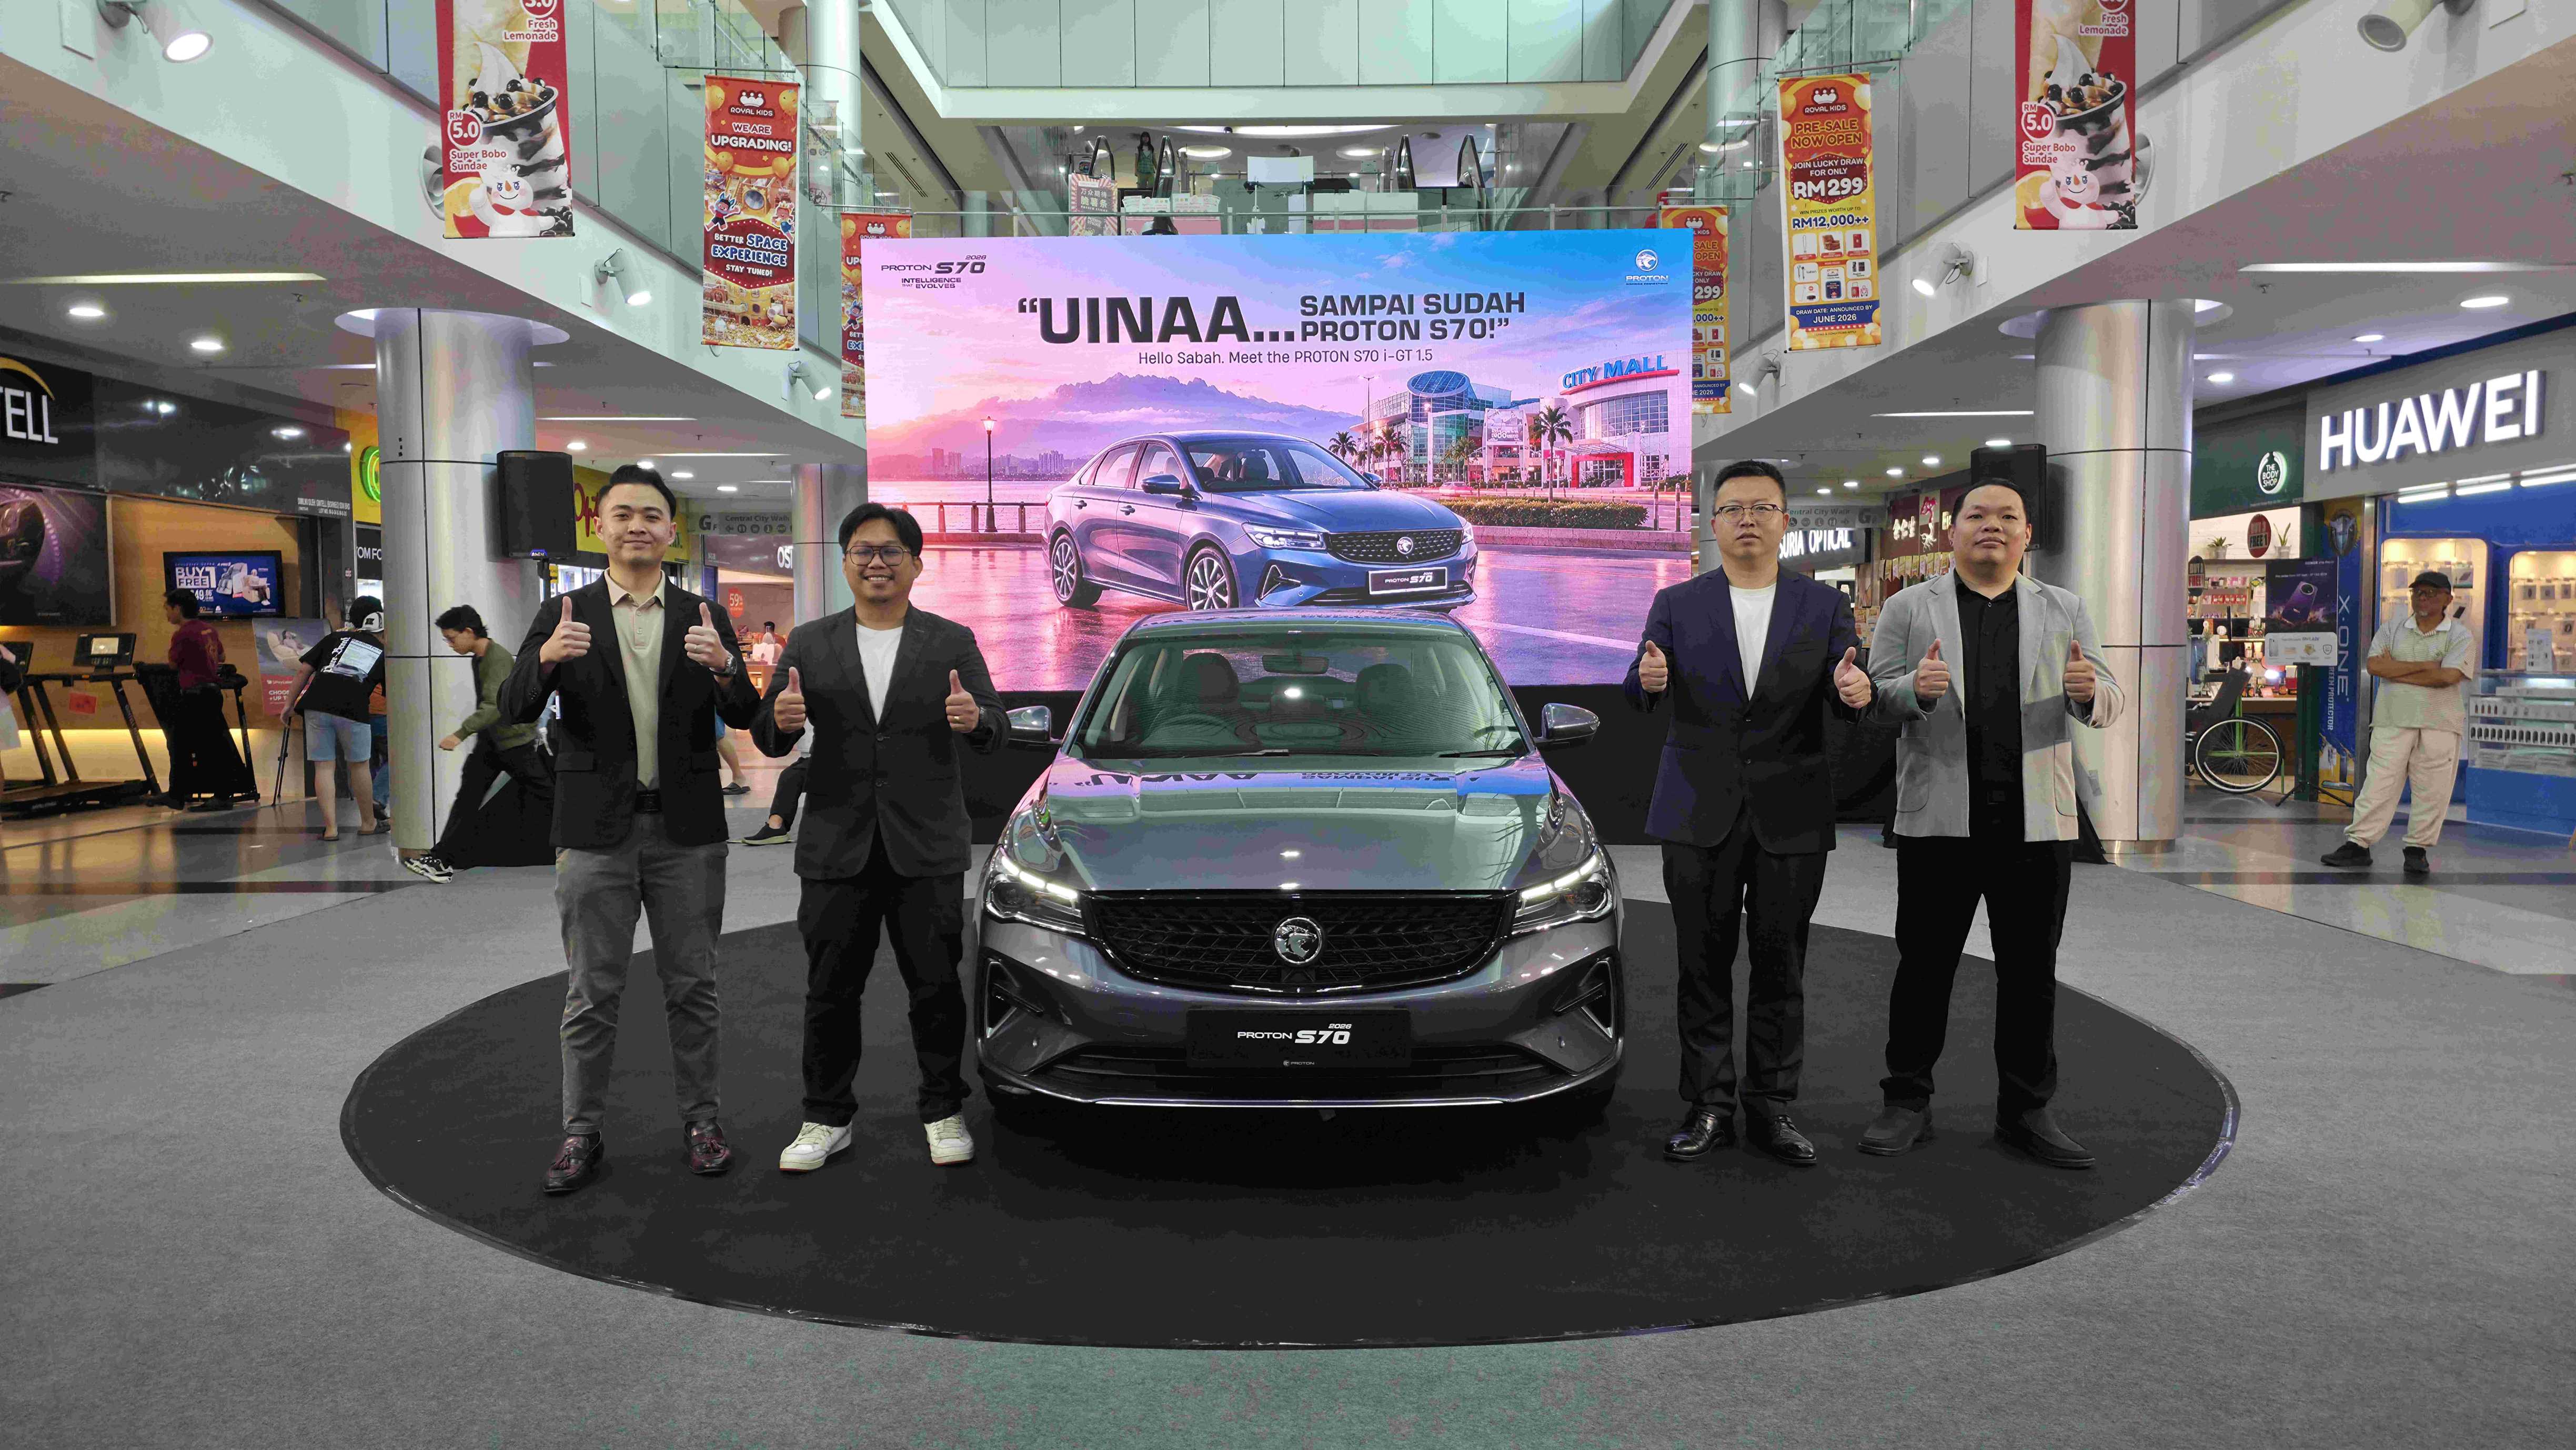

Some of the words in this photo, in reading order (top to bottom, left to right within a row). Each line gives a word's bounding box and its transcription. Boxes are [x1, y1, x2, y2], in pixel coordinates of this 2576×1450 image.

[528, 19, 555, 28] Fresh
[2102, 14, 2126, 23] Fresh
[504, 32, 556, 40] Lemonade
[2079, 25, 2127, 34] Lemonade
[733, 123, 749, 132] WE
[751, 124, 771, 134] ARE
[1795, 119, 1858, 134] PRE-SALE
[2027, 114, 2052, 131] 5.0
[453, 122, 479, 138] 5.0
[711, 135, 792, 152] UPGRADING!
[1792, 135, 1824, 148] NOW
[1827, 133, 1862, 145] OPEN
[451, 151, 479, 160] Super
[481, 149, 507, 158] Bobo
[2024, 143, 2051, 153] Super
[2054, 143, 2076, 152] Bobo
[1793, 161, 1811, 169] JOIN
[1813, 159, 1839, 168] LUCKY
[2024, 154, 2058, 163] Sundae
[452, 161, 487, 170] Sundae
[1793, 180, 1825, 198] RM
[1827, 177, 1863, 196] 299
[1792, 214, 1869, 229] RM12,000++
[715, 233, 744, 244] BETTER
[747, 234, 787, 251] SPACE
[712, 245, 787, 266] EXPERIENCE
[1695, 252, 1721, 261] OPEN
[726, 264, 744, 273] STAY
[747, 267, 772, 277] TUNED!
[934, 262, 985, 274] S70
[1300, 294, 1414, 317] SAMPAI
[1423, 292, 1524, 315] SUDAH
[1301, 319, 1420, 342] PROTON
[1139, 352, 1173, 364] Hello
[1178, 351, 1224, 364] Sabah.
[1230, 351, 1263, 364] Meet
[1267, 351, 1290, 363] the
[1295, 350, 1349, 363] PROTON
[1354, 349, 1379, 362] S70
[1384, 349, 1412, 362] i-GT
[1416, 348, 1433, 361] 1.5
[1562, 366, 1597, 388] CITY
[1604, 355, 1668, 379] MALL
[0, 386, 58, 444] ELL
[2320, 369, 2543, 471] HUAWEI
[2262, 470, 2280, 480] BODY
[2262, 478, 2277, 487] SHOP
[1808, 529, 1852, 553] OPTICAL
[2250, 535, 2263, 548] FREE
[356, 546, 370, 559] OM
[176, 566, 205, 577] BUY
[205, 566, 216, 588] 1
[178, 578, 208, 587] FREE
[1410, 575, 1433, 583] S70
[1294, 1030, 1351, 1044] S70
